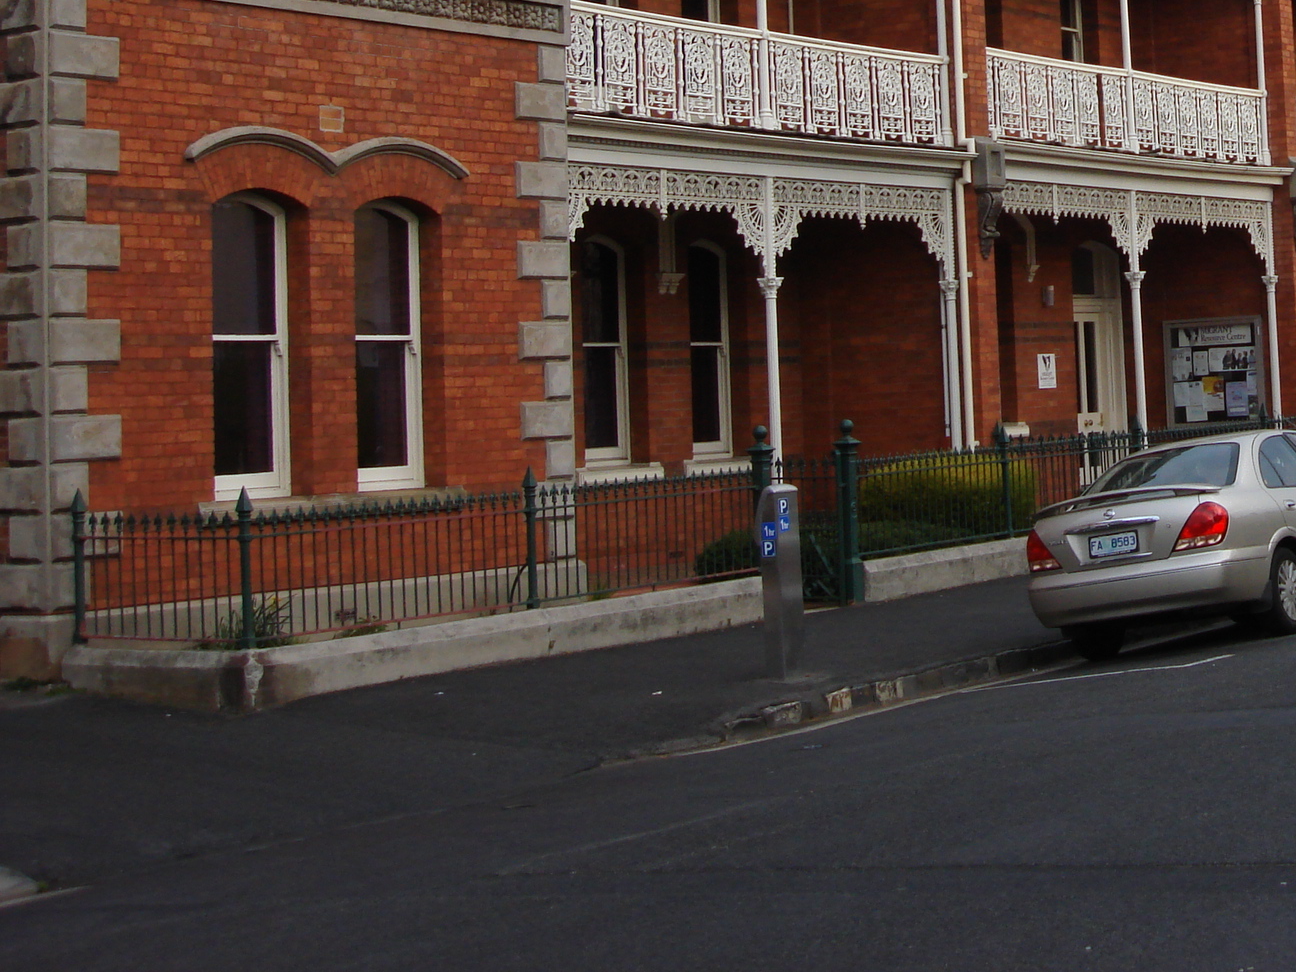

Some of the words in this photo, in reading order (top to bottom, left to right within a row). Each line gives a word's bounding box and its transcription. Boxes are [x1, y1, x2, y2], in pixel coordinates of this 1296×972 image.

[1201, 325, 1232, 334] MIGRANT
[780, 500, 786, 513] P
[764, 542, 772, 555] P
[1091, 540, 1103, 551] FA
[1111, 535, 1135, 548] 8583
